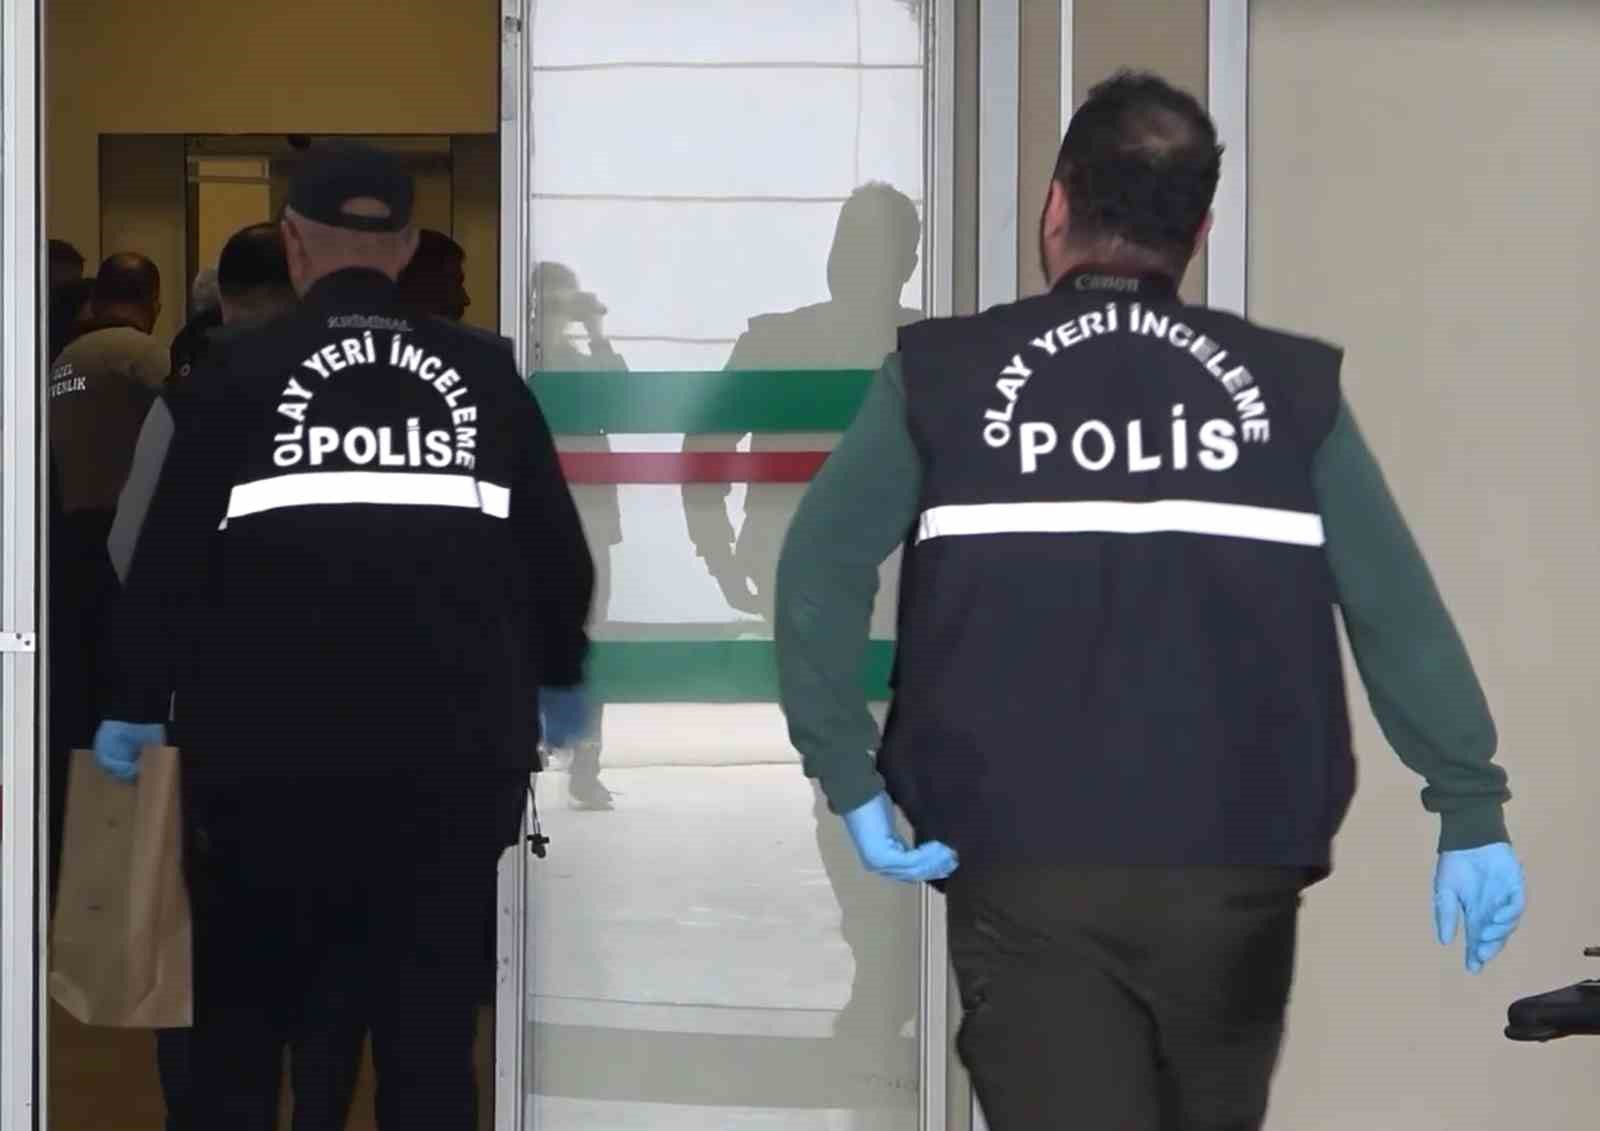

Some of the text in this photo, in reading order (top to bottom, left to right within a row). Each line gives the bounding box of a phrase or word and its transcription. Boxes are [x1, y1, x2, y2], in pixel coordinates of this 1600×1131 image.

[274, 330, 477, 470] OLAY YERİ İNCELEME
[983, 302, 1270, 448] OLAY YERİ İNCELEME
[308, 416, 453, 468] POLİS
[1019, 403, 1239, 473] POLİS
